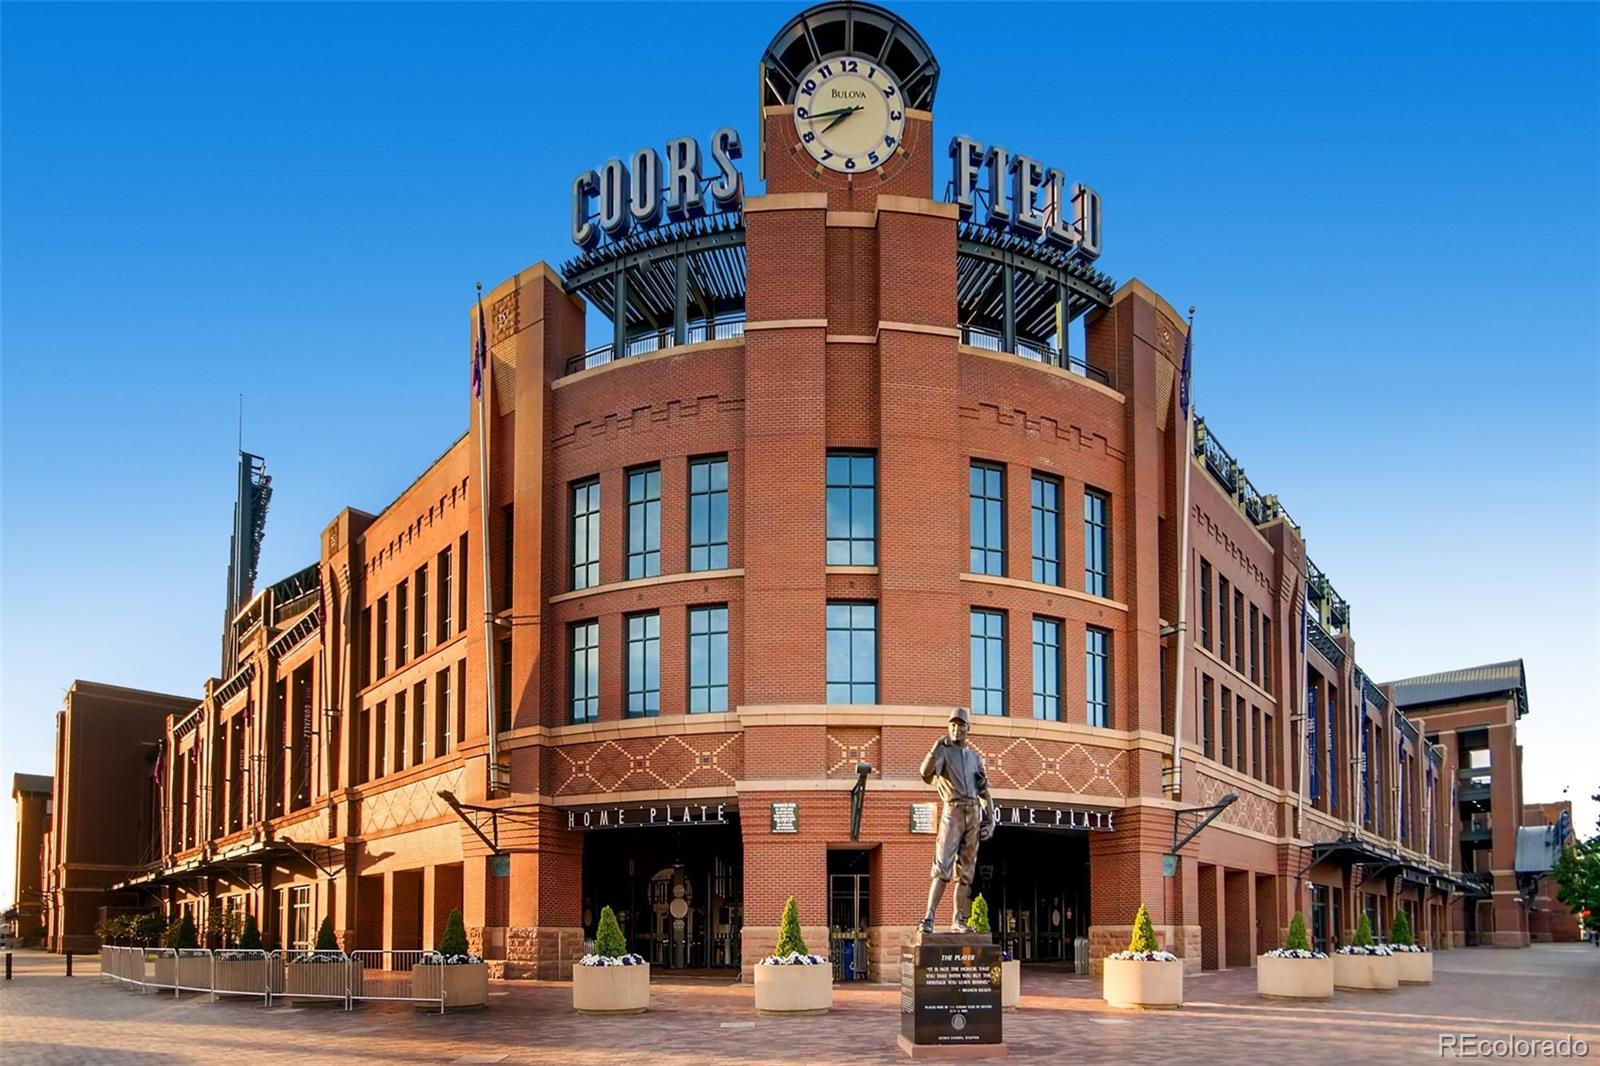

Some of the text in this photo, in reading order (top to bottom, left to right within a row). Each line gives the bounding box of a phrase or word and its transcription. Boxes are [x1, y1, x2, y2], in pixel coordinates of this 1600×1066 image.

[817, 65, 833, 79] 11
[840, 61, 858, 73] 12
[867, 67, 876, 78] 1
[801, 80, 817, 97] 10
[882, 86, 896, 99] 2
[797, 107, 809, 119] 9
[890, 110, 902, 121] 3
[802, 131, 815, 144] 8
[883, 135, 896, 147] 4
[821, 150, 833, 162] 7
[868, 151, 879, 164] 5
[845, 158, 856, 169] 6
[572, 127, 742, 248] COORS
[949, 135, 1103, 260] FIELD
[568, 805, 724, 828] HOME PLATE
[1056, 809, 1113, 829] PLATE
